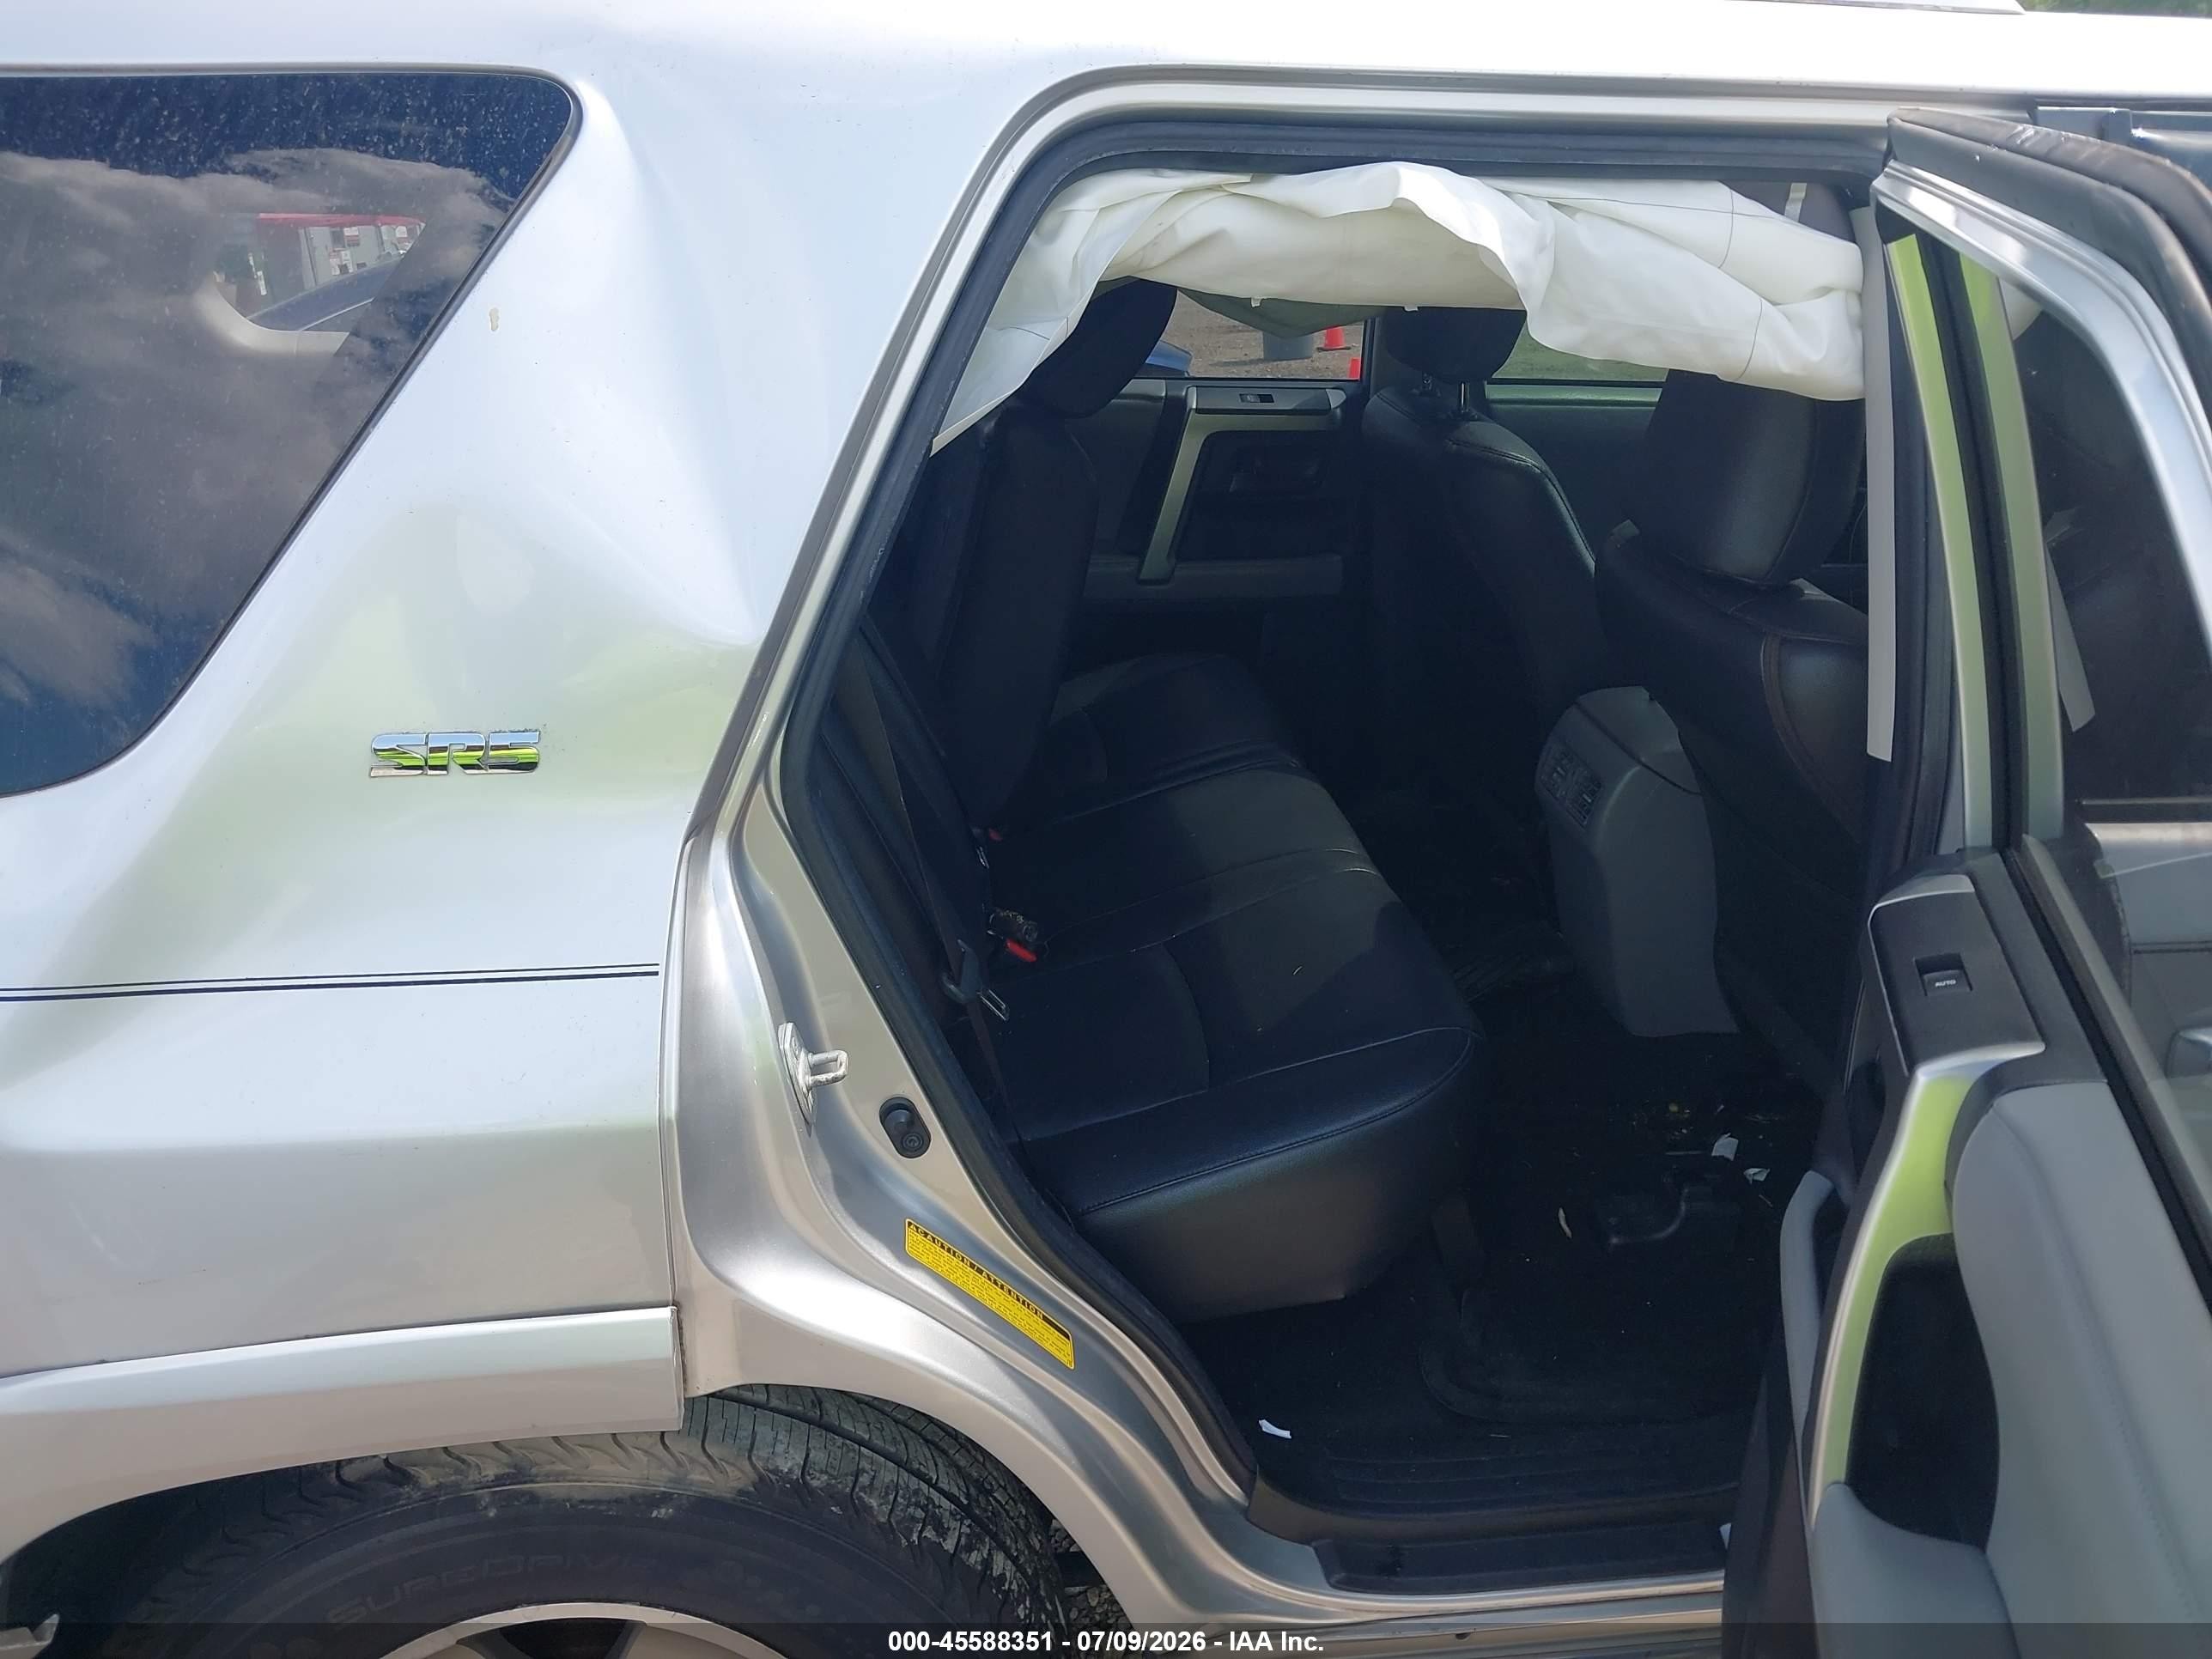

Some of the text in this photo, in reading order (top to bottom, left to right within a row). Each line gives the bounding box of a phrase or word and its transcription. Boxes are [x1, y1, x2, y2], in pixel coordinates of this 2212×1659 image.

[368, 730, 541, 777] SR5
[1935, 979, 1957, 988] AUTO
[918, 1228, 970, 1267] CAUTION
[981, 1272, 1043, 1320] ATTENTION
